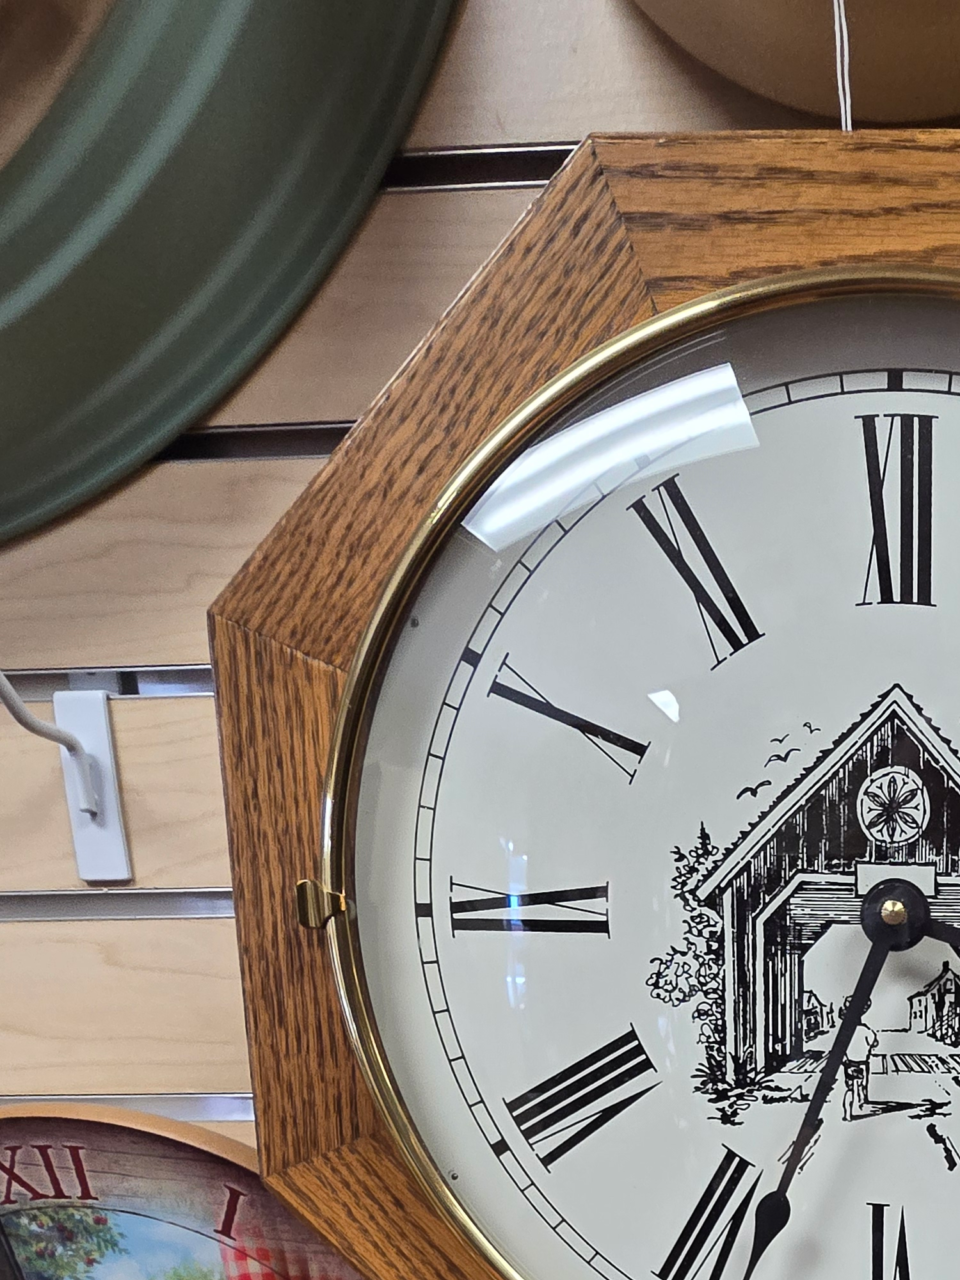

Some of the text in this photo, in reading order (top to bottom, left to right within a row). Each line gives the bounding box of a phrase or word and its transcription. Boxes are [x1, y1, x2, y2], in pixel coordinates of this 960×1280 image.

[626, 473, 766, 670] XI
[855, 414, 938, 607] XII
[487, 654, 651, 784] X
[449, 876, 611, 938] IX
[504, 1023, 662, 1173] VIII
[0, 1144, 100, 1203] XII
[213, 1184, 248, 1240] I
